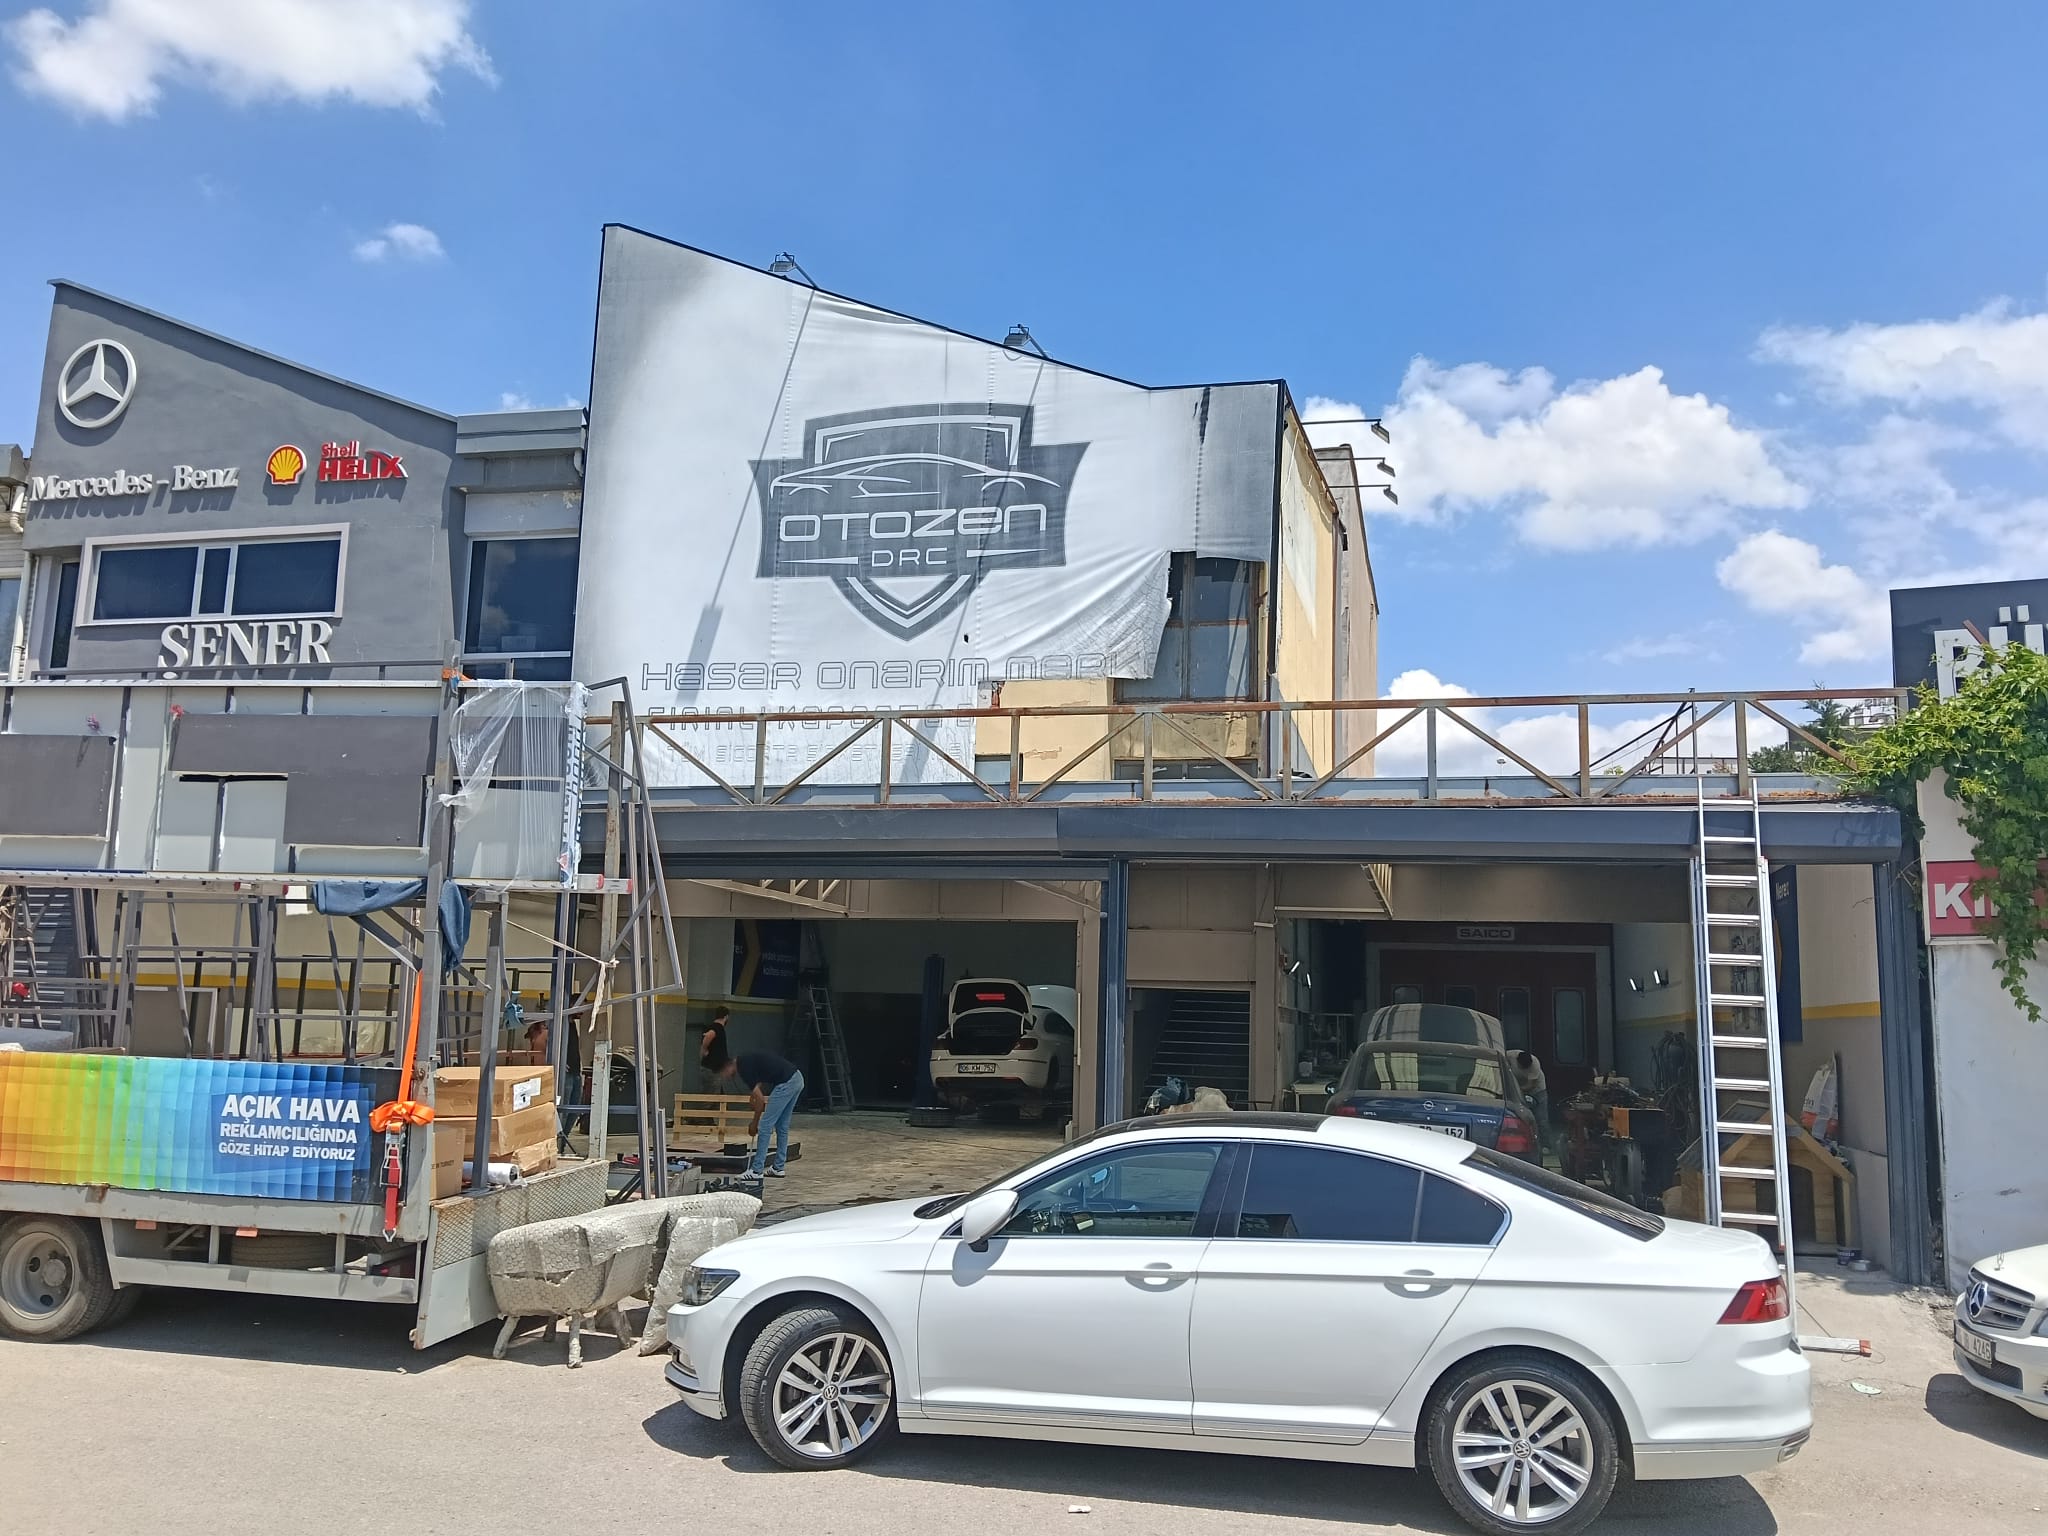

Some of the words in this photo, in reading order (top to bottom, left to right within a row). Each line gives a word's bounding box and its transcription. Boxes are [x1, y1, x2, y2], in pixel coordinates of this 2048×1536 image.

[320, 441, 359, 458] Shell
[318, 449, 408, 482] HELIX
[871, 547, 948, 568] DRC
[1460, 927, 1512, 939] SAICO
[221, 1094, 282, 1123] AÇIK
[289, 1097, 361, 1124] HAVA
[220, 1122, 358, 1144] REKLAMCILIĞINDA
[218, 1140, 251, 1155] GÖZE
[254, 1141, 289, 1157] HİTAP
[292, 1143, 356, 1161] EDİYORUZ
